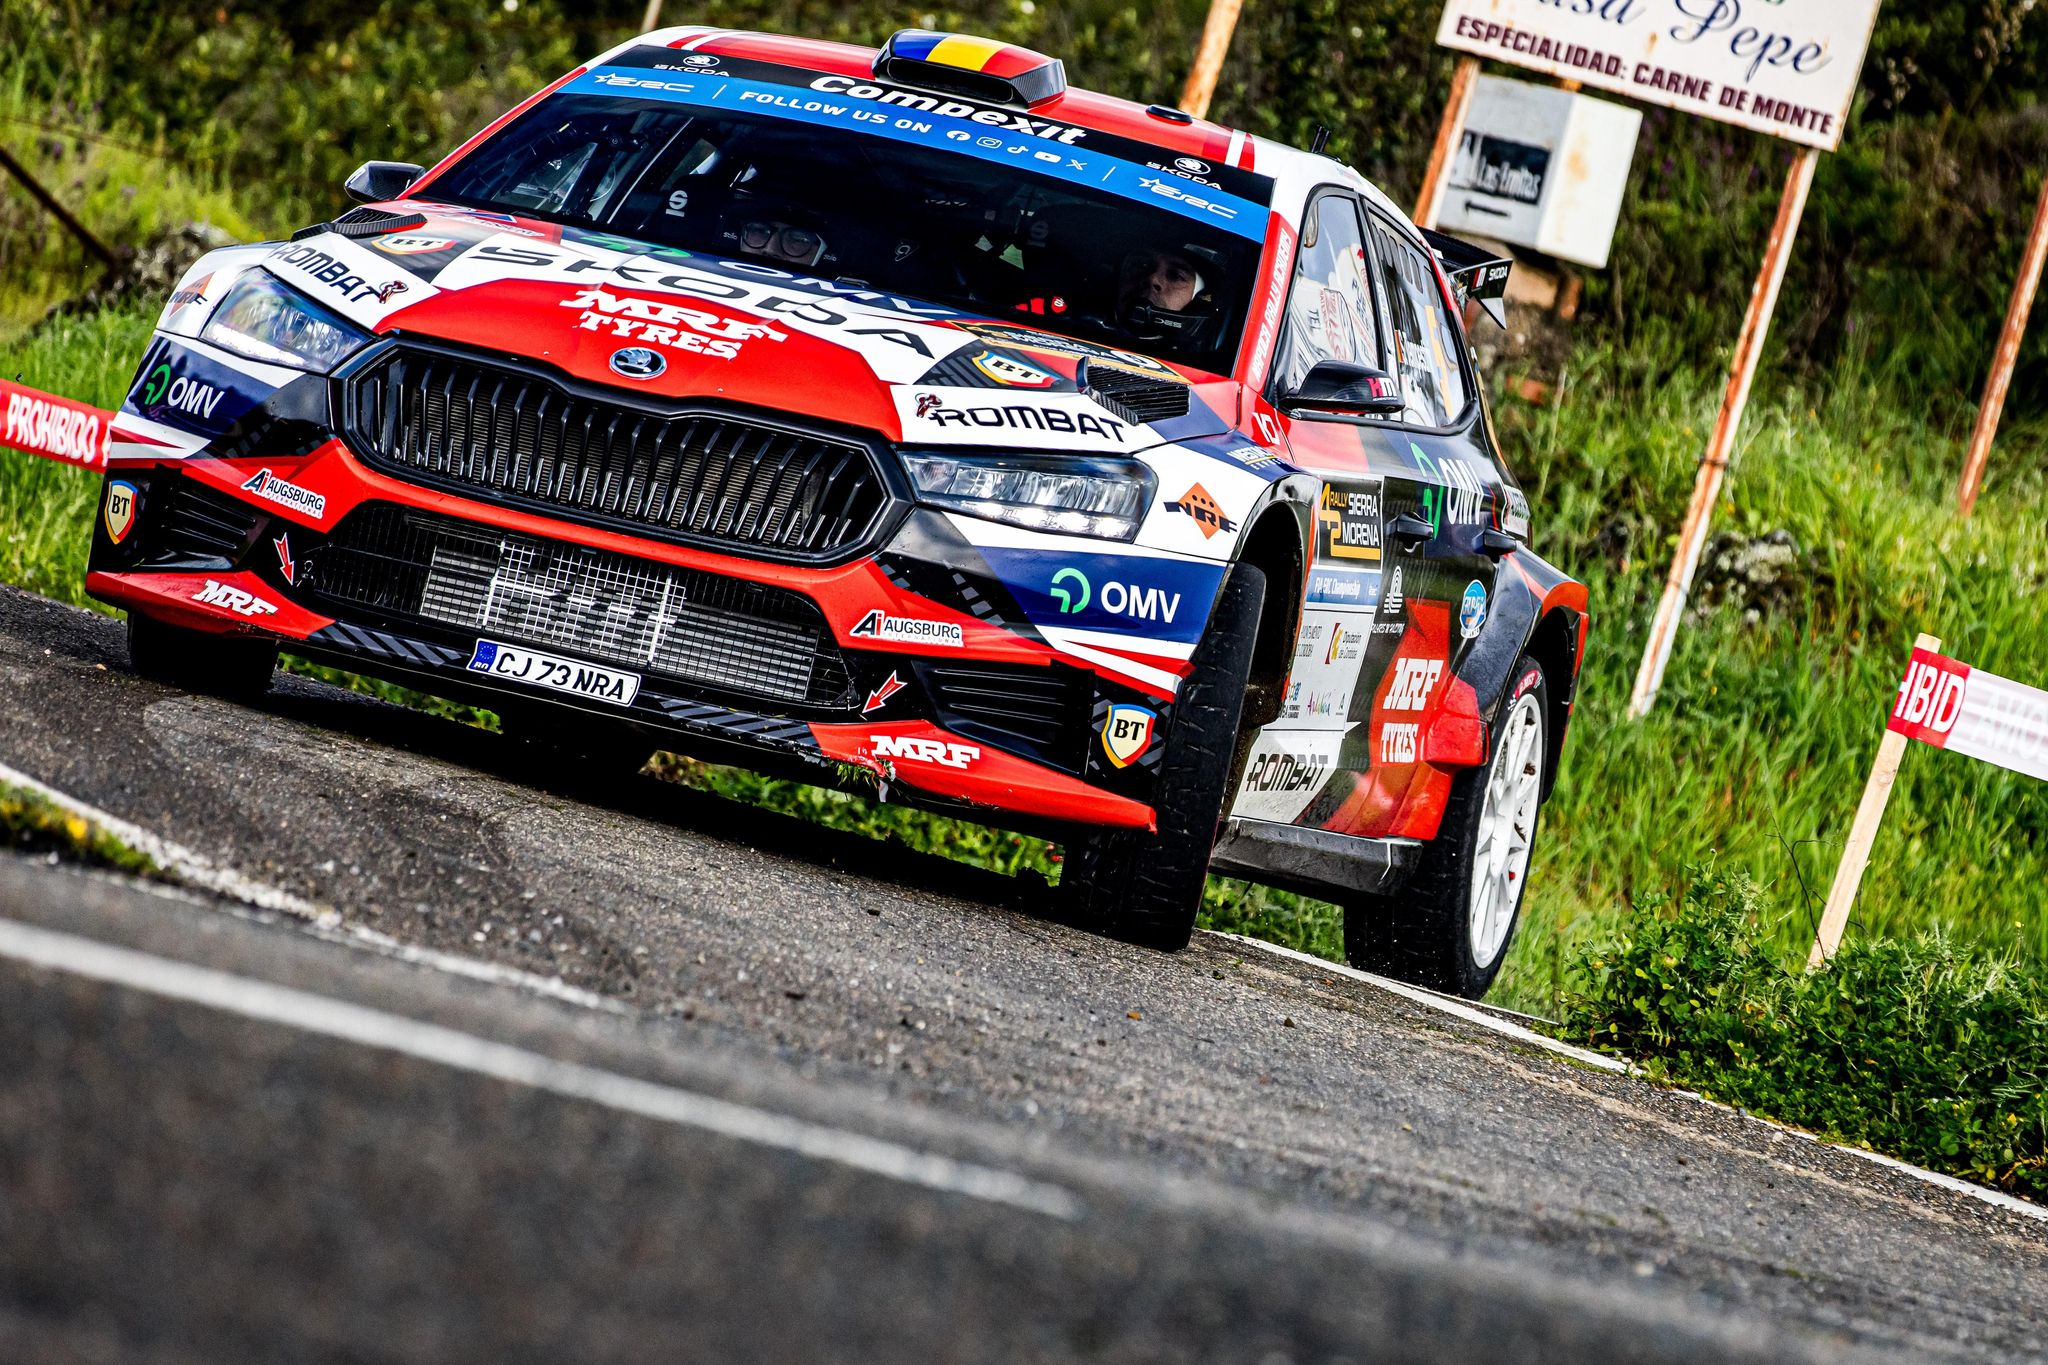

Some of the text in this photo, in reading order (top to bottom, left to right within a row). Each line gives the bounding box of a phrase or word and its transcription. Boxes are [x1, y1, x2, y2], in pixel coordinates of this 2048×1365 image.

[1670, 0, 1832, 83] Pepe
[1456, 14, 1836, 136] ESPECIALIDAD: CARNE DE MONTE
[739, 91, 933, 133] FOLLOW US ON
[269, 243, 384, 304] ROMBAT
[559, 289, 789, 343] MRF
[1264, 281, 1283, 331] RALLY
[578, 311, 743, 361] TYRES
[991, 359, 1041, 379] BT
[167, 377, 225, 419] OMV
[5, 392, 99, 464] PROHIBIDO
[928, 405, 1125, 443] ROMBAT
[111, 494, 130, 517] BT
[267, 479, 323, 511] AUGSBURG
[1329, 491, 1379, 517] RALLY SIERRA
[1438, 456, 1484, 525] OMV
[1163, 501, 1238, 534] NRF
[1342, 521, 1379, 546] MORENA
[191, 579, 279, 616] MRF
[1100, 581, 1181, 623] OMV
[883, 616, 961, 640] AUGSBURG
[496, 652, 623, 700] CJ 73 NRA
[1382, 657, 1444, 711] MRF
[1113, 718, 1144, 741] BT
[1381, 722, 1420, 763] TYRES
[869, 734, 980, 770] MRF
[1246, 753, 1329, 792] ROMBAT
